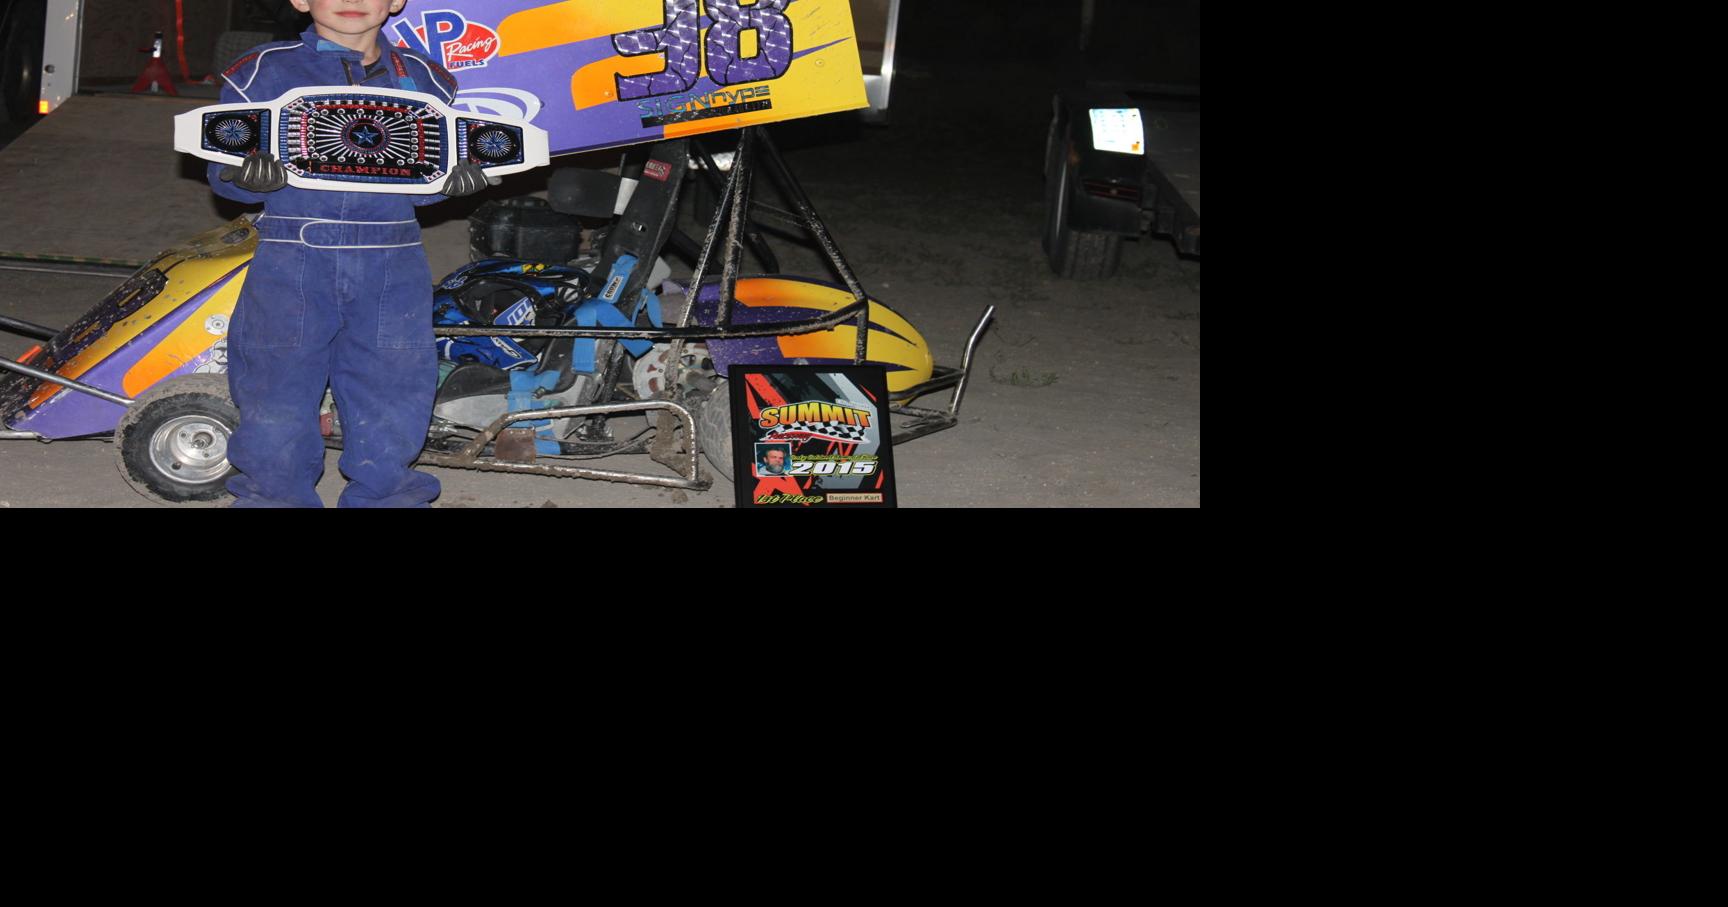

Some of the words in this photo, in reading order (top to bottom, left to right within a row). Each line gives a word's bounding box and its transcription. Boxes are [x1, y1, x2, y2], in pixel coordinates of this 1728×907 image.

[446, 36, 497, 61] Racing
[611, 0, 793, 101] 38
[449, 60, 485, 68] FUELS
[320, 164, 411, 176] CHAMPION
[759, 401, 871, 428] SUMMIT
[788, 461, 878, 475] 2015
